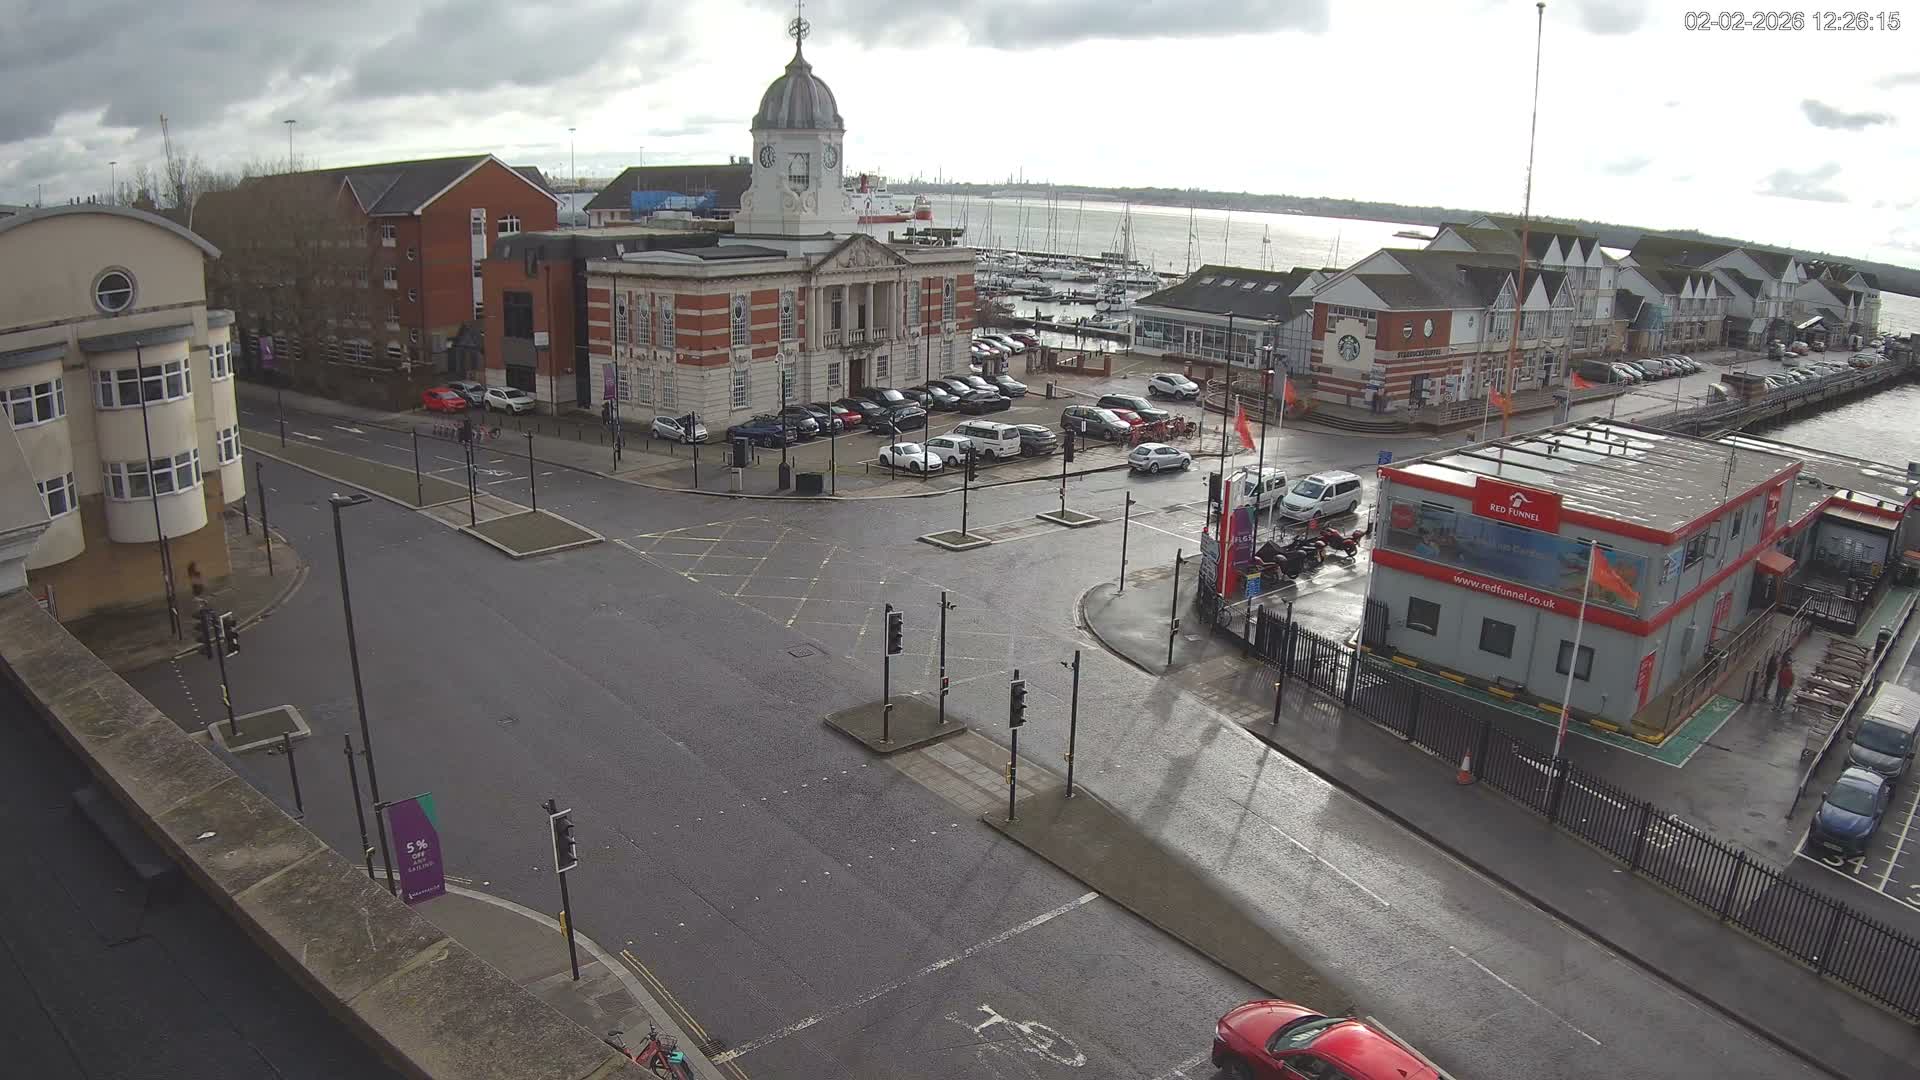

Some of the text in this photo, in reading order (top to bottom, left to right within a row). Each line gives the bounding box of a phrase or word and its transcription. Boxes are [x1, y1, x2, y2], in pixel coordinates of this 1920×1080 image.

[1490, 503, 1540, 522] RED FUNNEL
[1453, 574, 1556, 609] www.redfunnel.co.uk
[412, 850, 425, 860] OFF
